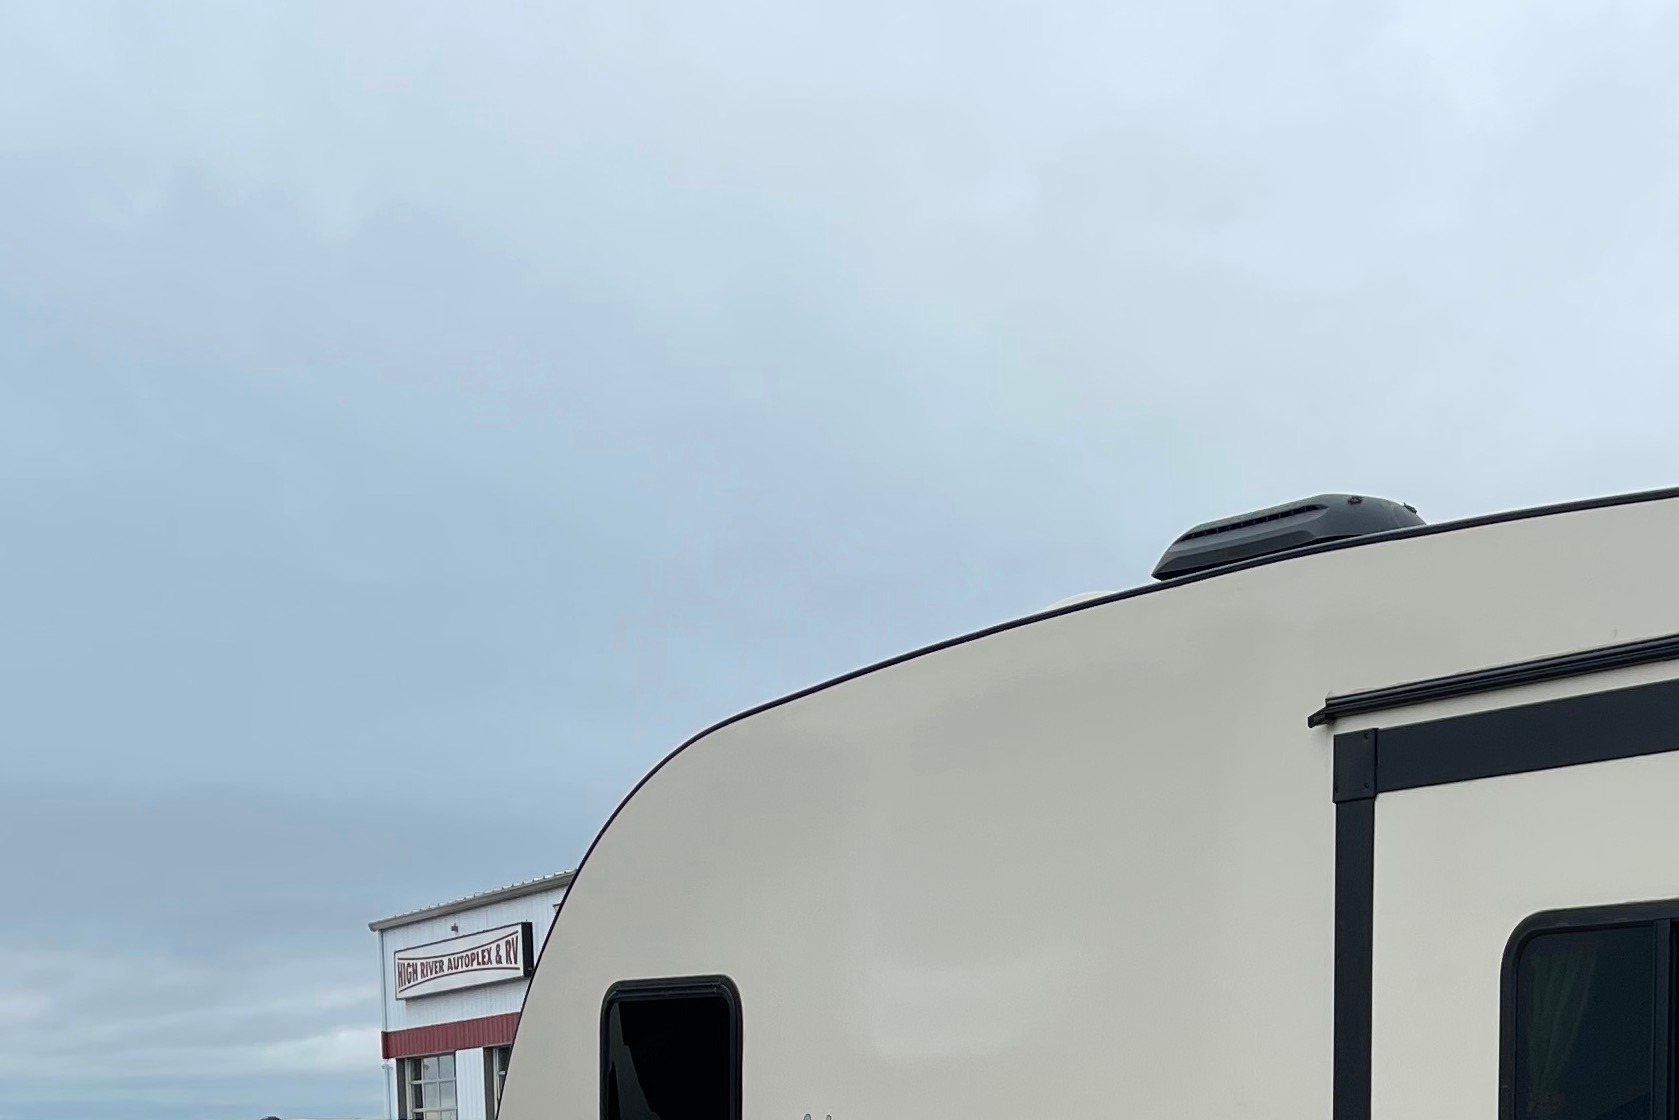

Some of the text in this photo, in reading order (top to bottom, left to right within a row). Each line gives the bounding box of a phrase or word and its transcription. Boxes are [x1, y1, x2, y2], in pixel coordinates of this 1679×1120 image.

[397, 935, 519, 988] HIGH RIVER AUTOPLEX & RV
